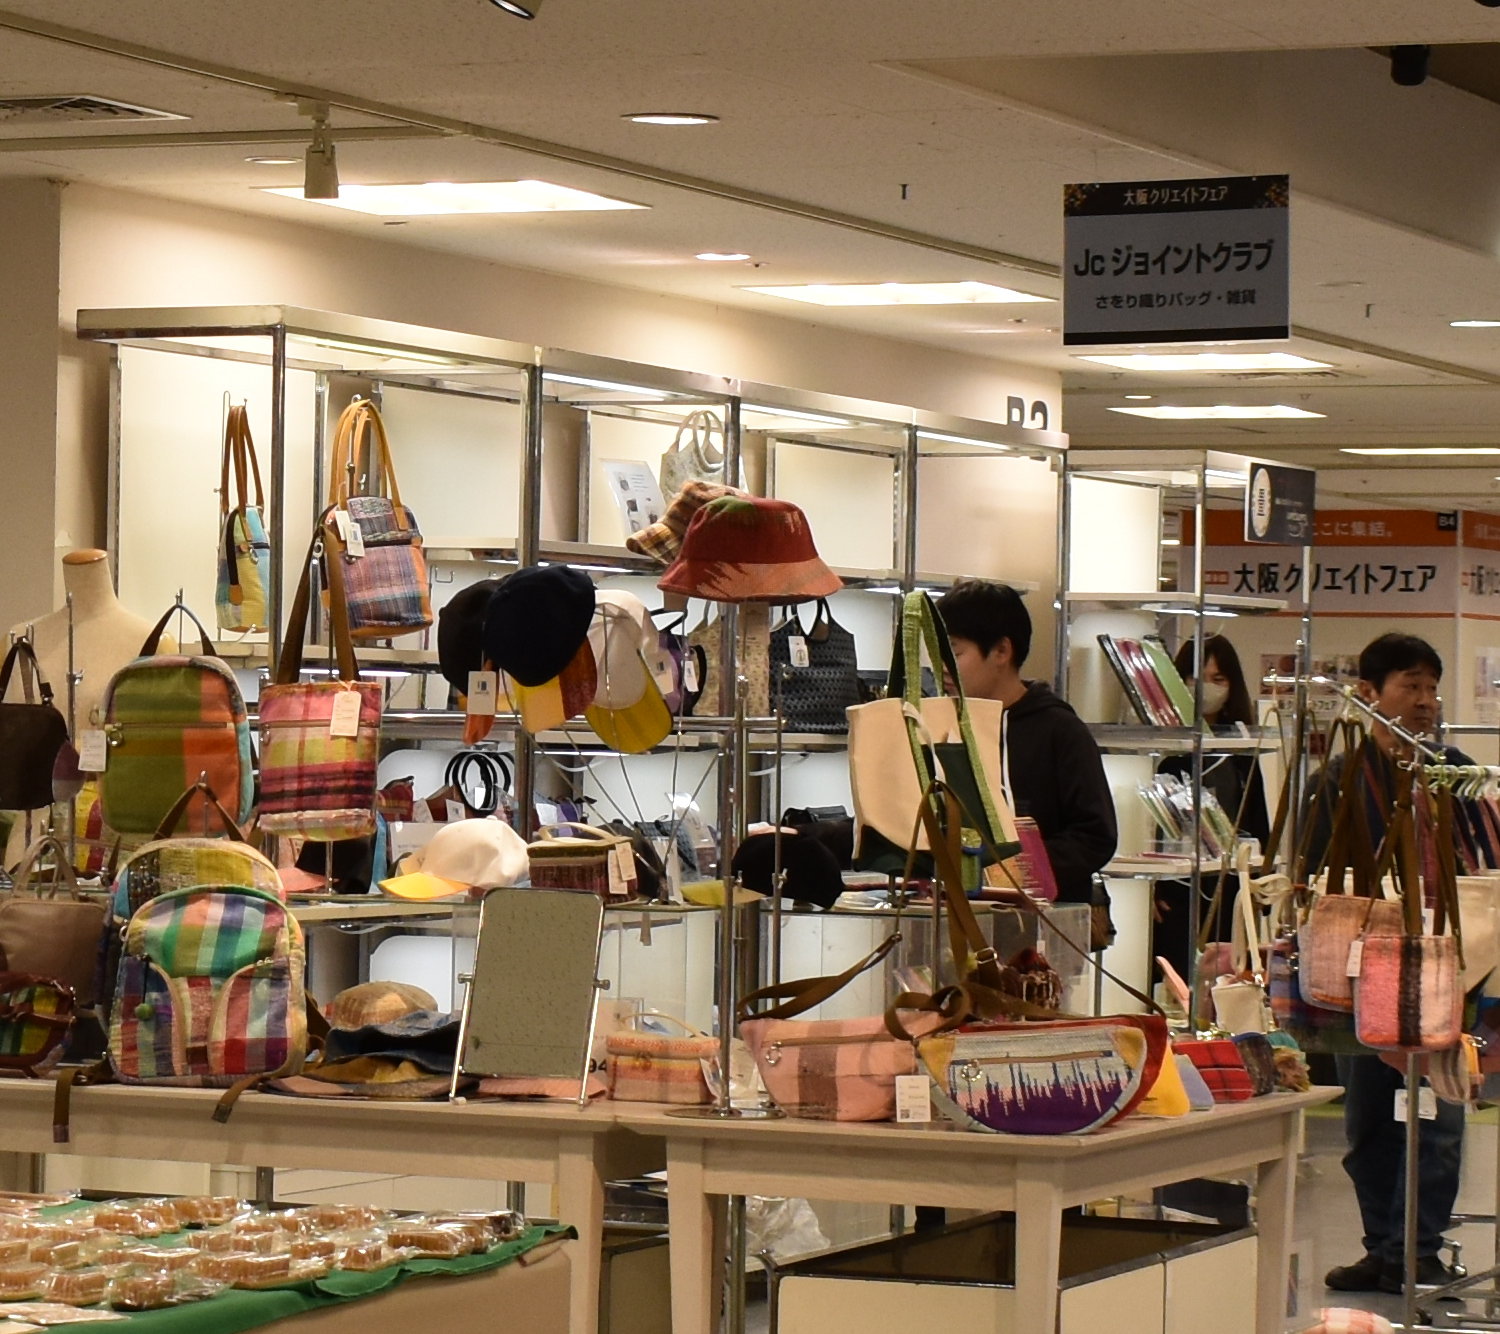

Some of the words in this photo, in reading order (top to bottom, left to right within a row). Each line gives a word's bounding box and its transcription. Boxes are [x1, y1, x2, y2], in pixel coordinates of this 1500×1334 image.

[1123, 185, 1228, 206] 大阪クリエイトフェア
[1113, 238, 1274, 277] ジョイントクラブ
